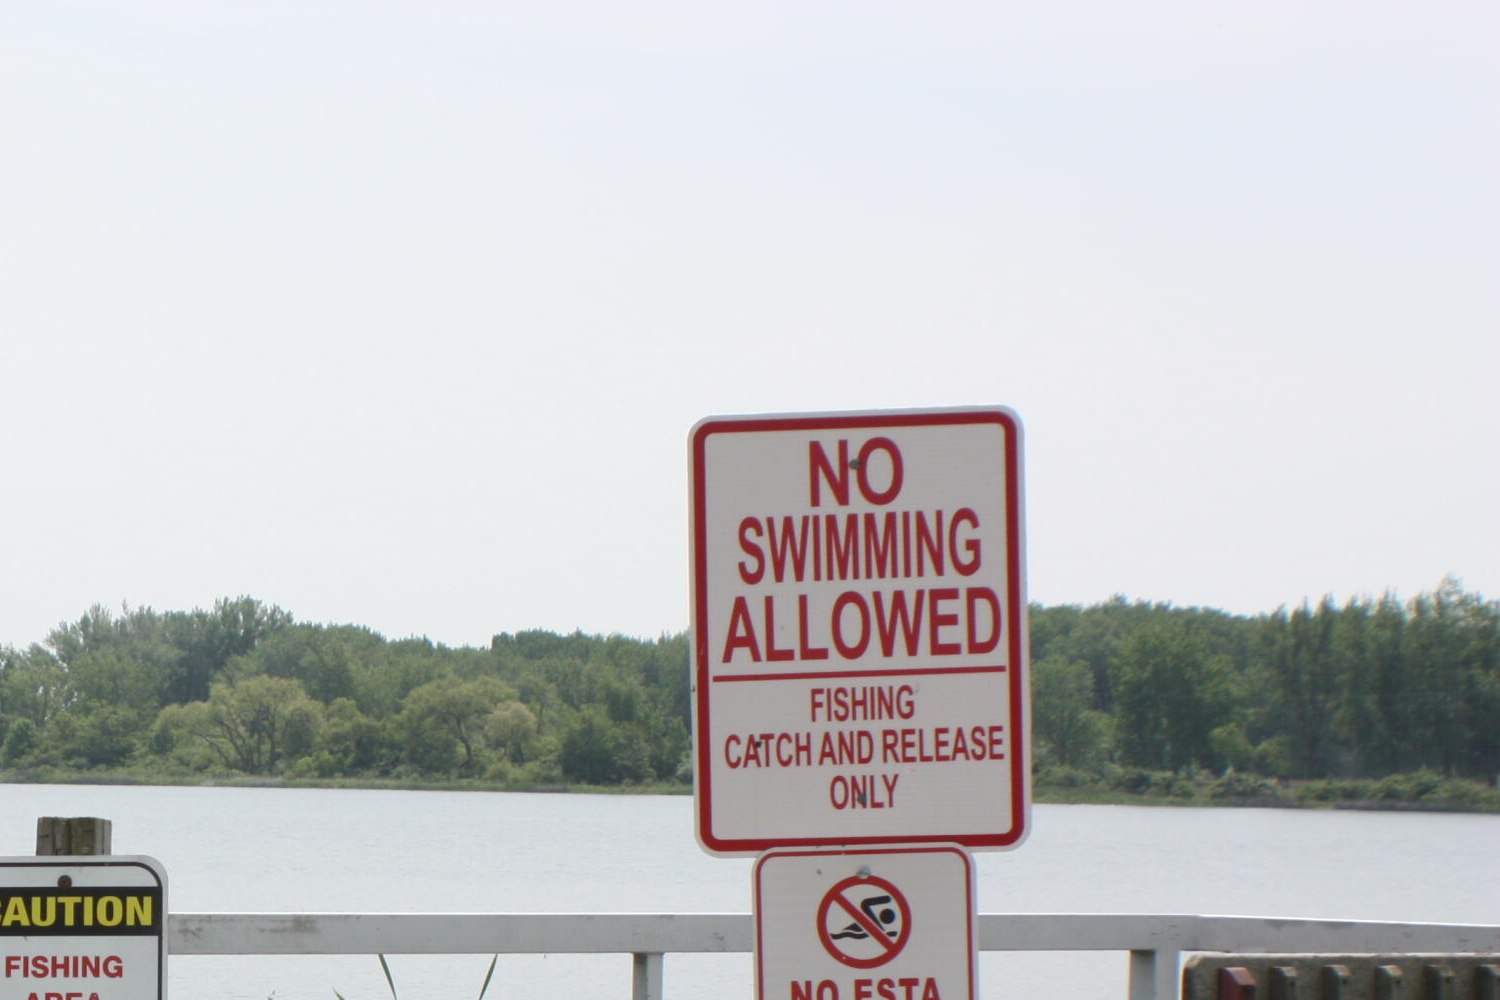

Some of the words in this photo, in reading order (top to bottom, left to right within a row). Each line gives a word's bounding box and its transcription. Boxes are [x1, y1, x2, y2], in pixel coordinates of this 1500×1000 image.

[809, 437, 904, 507] NO
[737, 507, 982, 585] SWIMMING
[722, 587, 1002, 663] ALLOWED
[810, 684, 915, 723] FISHING
[724, 732, 812, 768] CATCH
[818, 730, 873, 766] AND
[883, 726, 1005, 763] RELEASE
[829, 774, 899, 810] ONLY
[5, 956, 123, 978] FISHING
